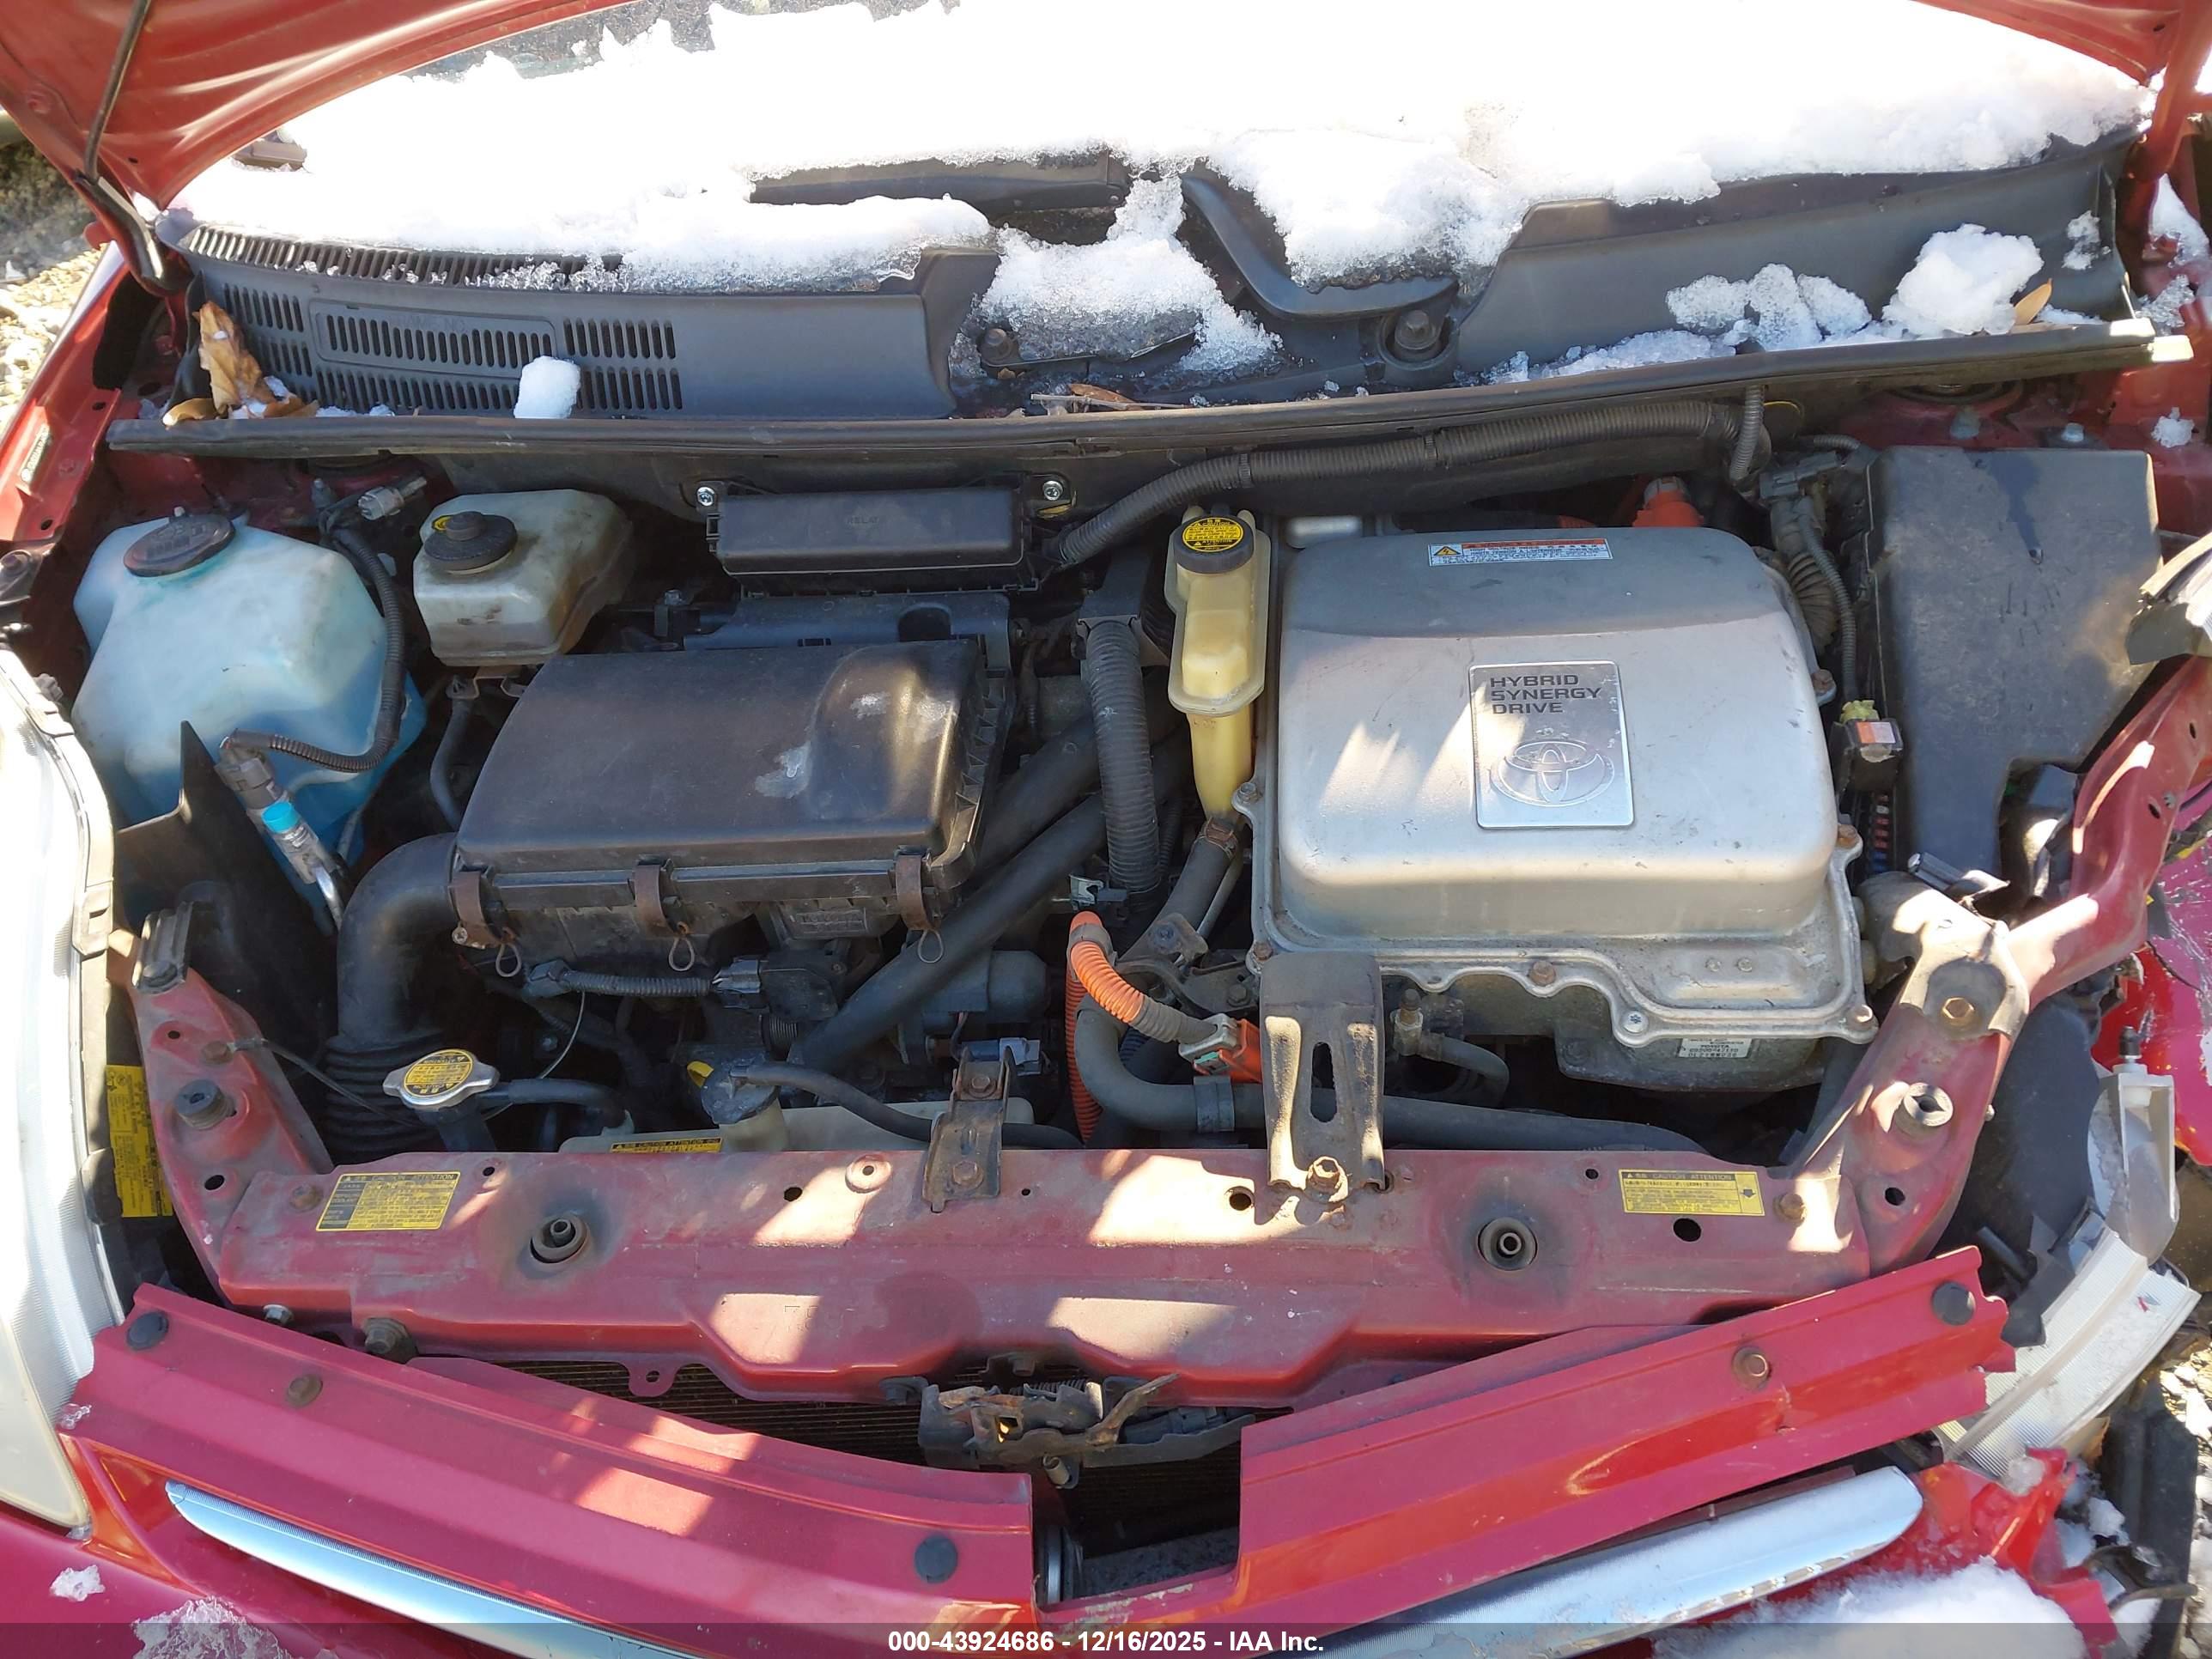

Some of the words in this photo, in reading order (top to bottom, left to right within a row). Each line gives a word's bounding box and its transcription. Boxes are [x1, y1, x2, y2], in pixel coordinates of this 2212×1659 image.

[1490, 675, 1578, 687] HYBRID
[1491, 688, 1601, 701] SYNERGY
[1492, 702, 1563, 714] DRIVE
